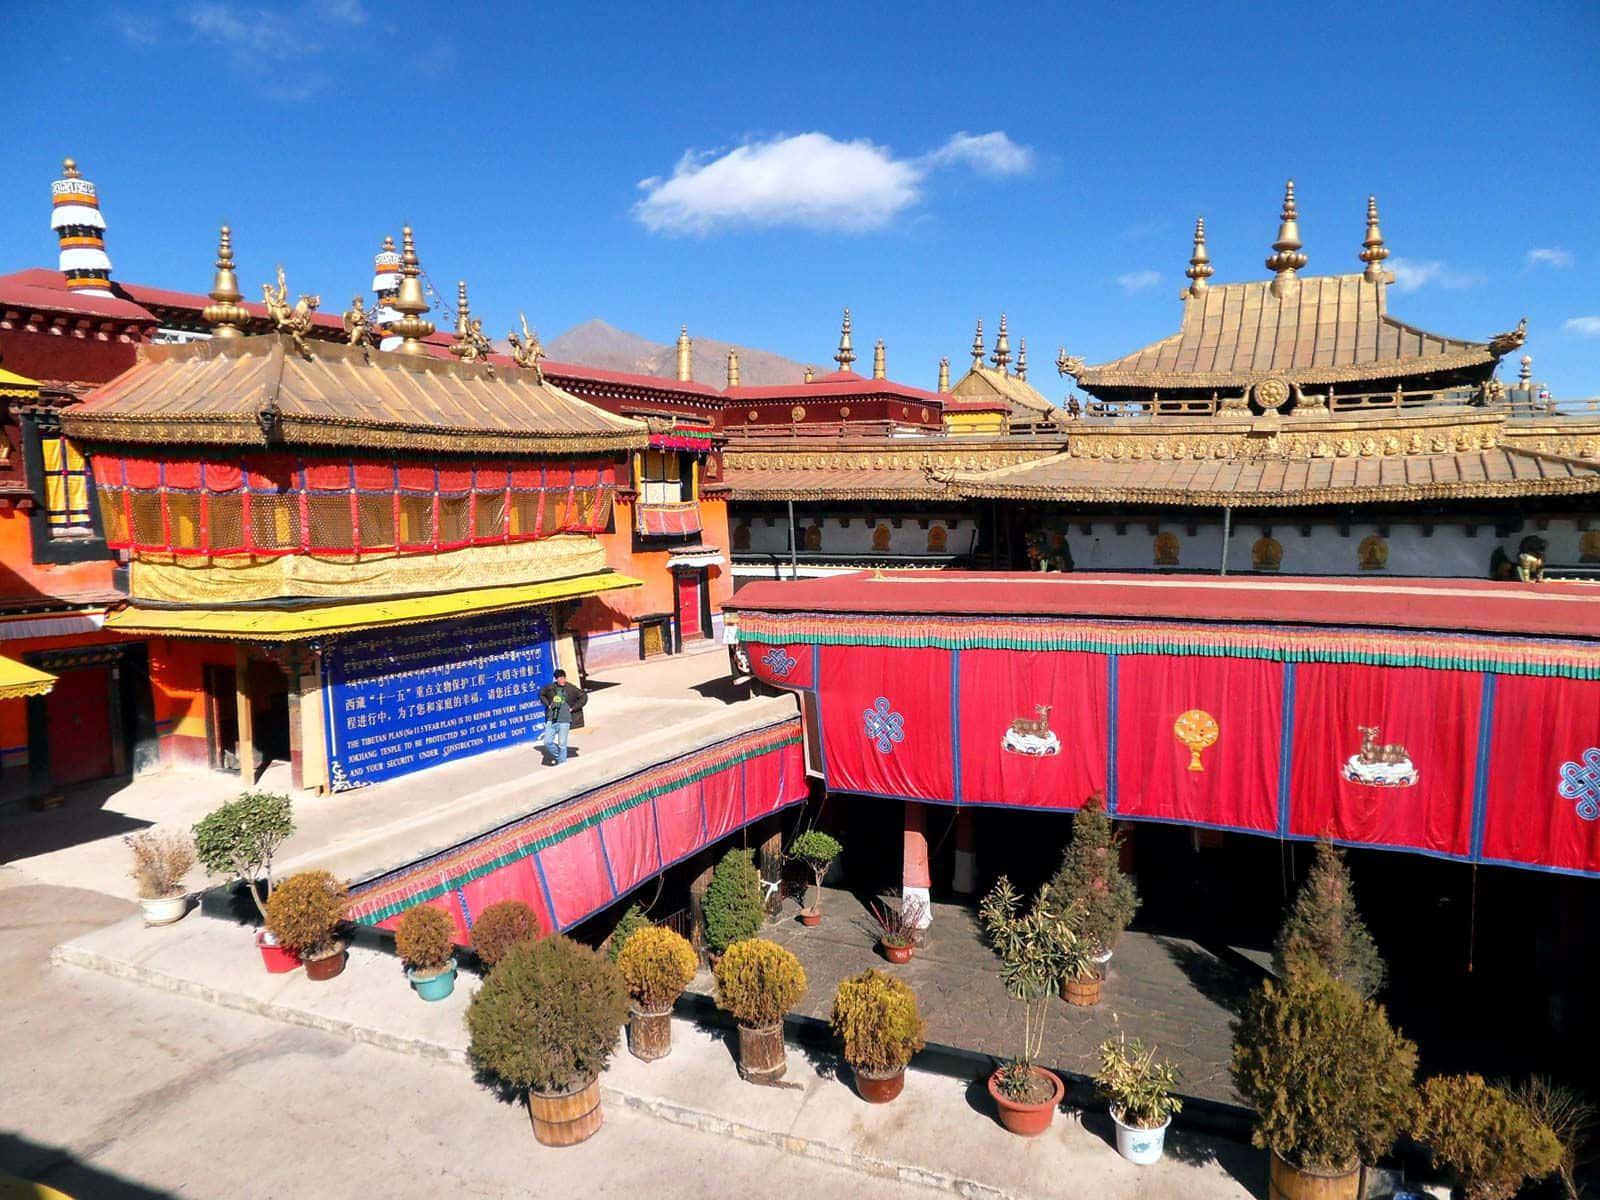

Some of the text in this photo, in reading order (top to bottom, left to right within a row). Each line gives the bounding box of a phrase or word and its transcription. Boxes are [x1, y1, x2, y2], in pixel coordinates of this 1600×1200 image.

[347, 741, 360, 749] THE
[361, 734, 388, 747] TIBETAN
[388, 730, 404, 740] PLAN
[424, 721, 440, 732] YEAR
[458, 717, 464, 725] IS
[465, 714, 472, 722] TO
[473, 709, 491, 720] REPAIR
[502, 704, 516, 714] VERY
[348, 750, 378, 764] JOKHANG
[404, 741, 412, 750] TO
[415, 739, 423, 747] BE
[425, 731, 458, 746] PROTECTED
[469, 726, 476, 734] IT
[476, 724, 487, 733] CAN
[490, 721, 497, 729] BE
[499, 719, 507, 727] TO
[509, 715, 524, 725] YOUR
[349, 767, 364, 777] AND
[366, 762, 384, 773] YOUR
[386, 754, 414, 768] SECURITY
[418, 748, 439, 760] UNDER
[443, 737, 484, 757] CONSTRUCTION
[487, 731, 507, 743] PLEASE
